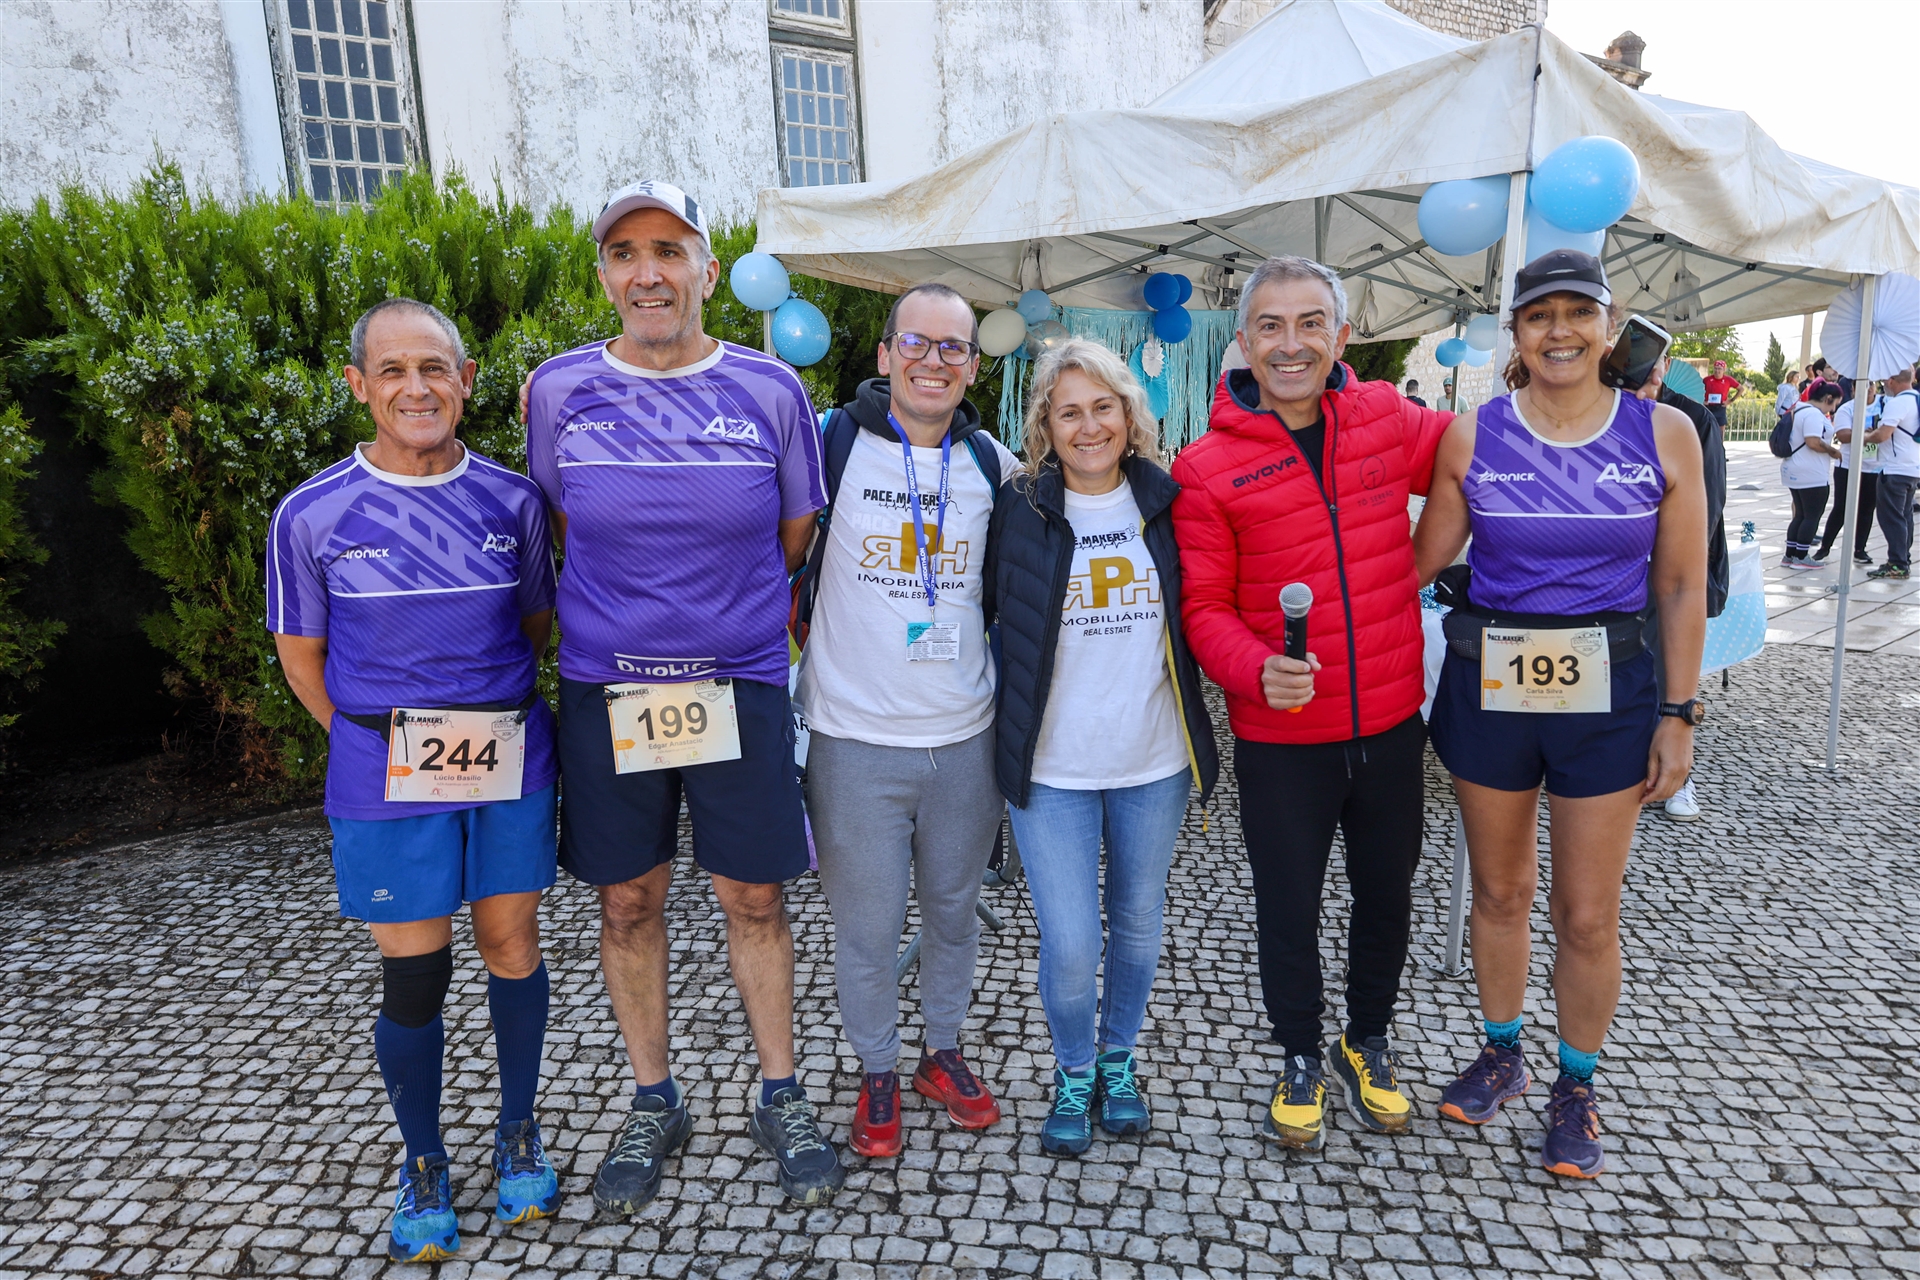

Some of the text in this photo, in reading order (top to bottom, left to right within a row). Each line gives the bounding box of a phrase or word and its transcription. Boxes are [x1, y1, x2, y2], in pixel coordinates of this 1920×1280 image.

[906, 455, 916, 490] DECATHLON
[1232, 455, 1298, 488] GIVOVA
[1596, 462, 1658, 486] AZA
[920, 547, 928, 580] DECATHLON
[858, 573, 965, 590] IMOBILRIA
[889, 590, 940, 600] REAL ESTE
[1060, 611, 1158, 626] MOBILIÁRIA
[1083, 625, 1132, 637] REAL ESTATE
[616, 659, 710, 677] DuoLi
[1509, 654, 1580, 686] 193
[637, 701, 708, 741] 199
[419, 737, 499, 772] 244
[648, 742, 668, 750] Edgar
